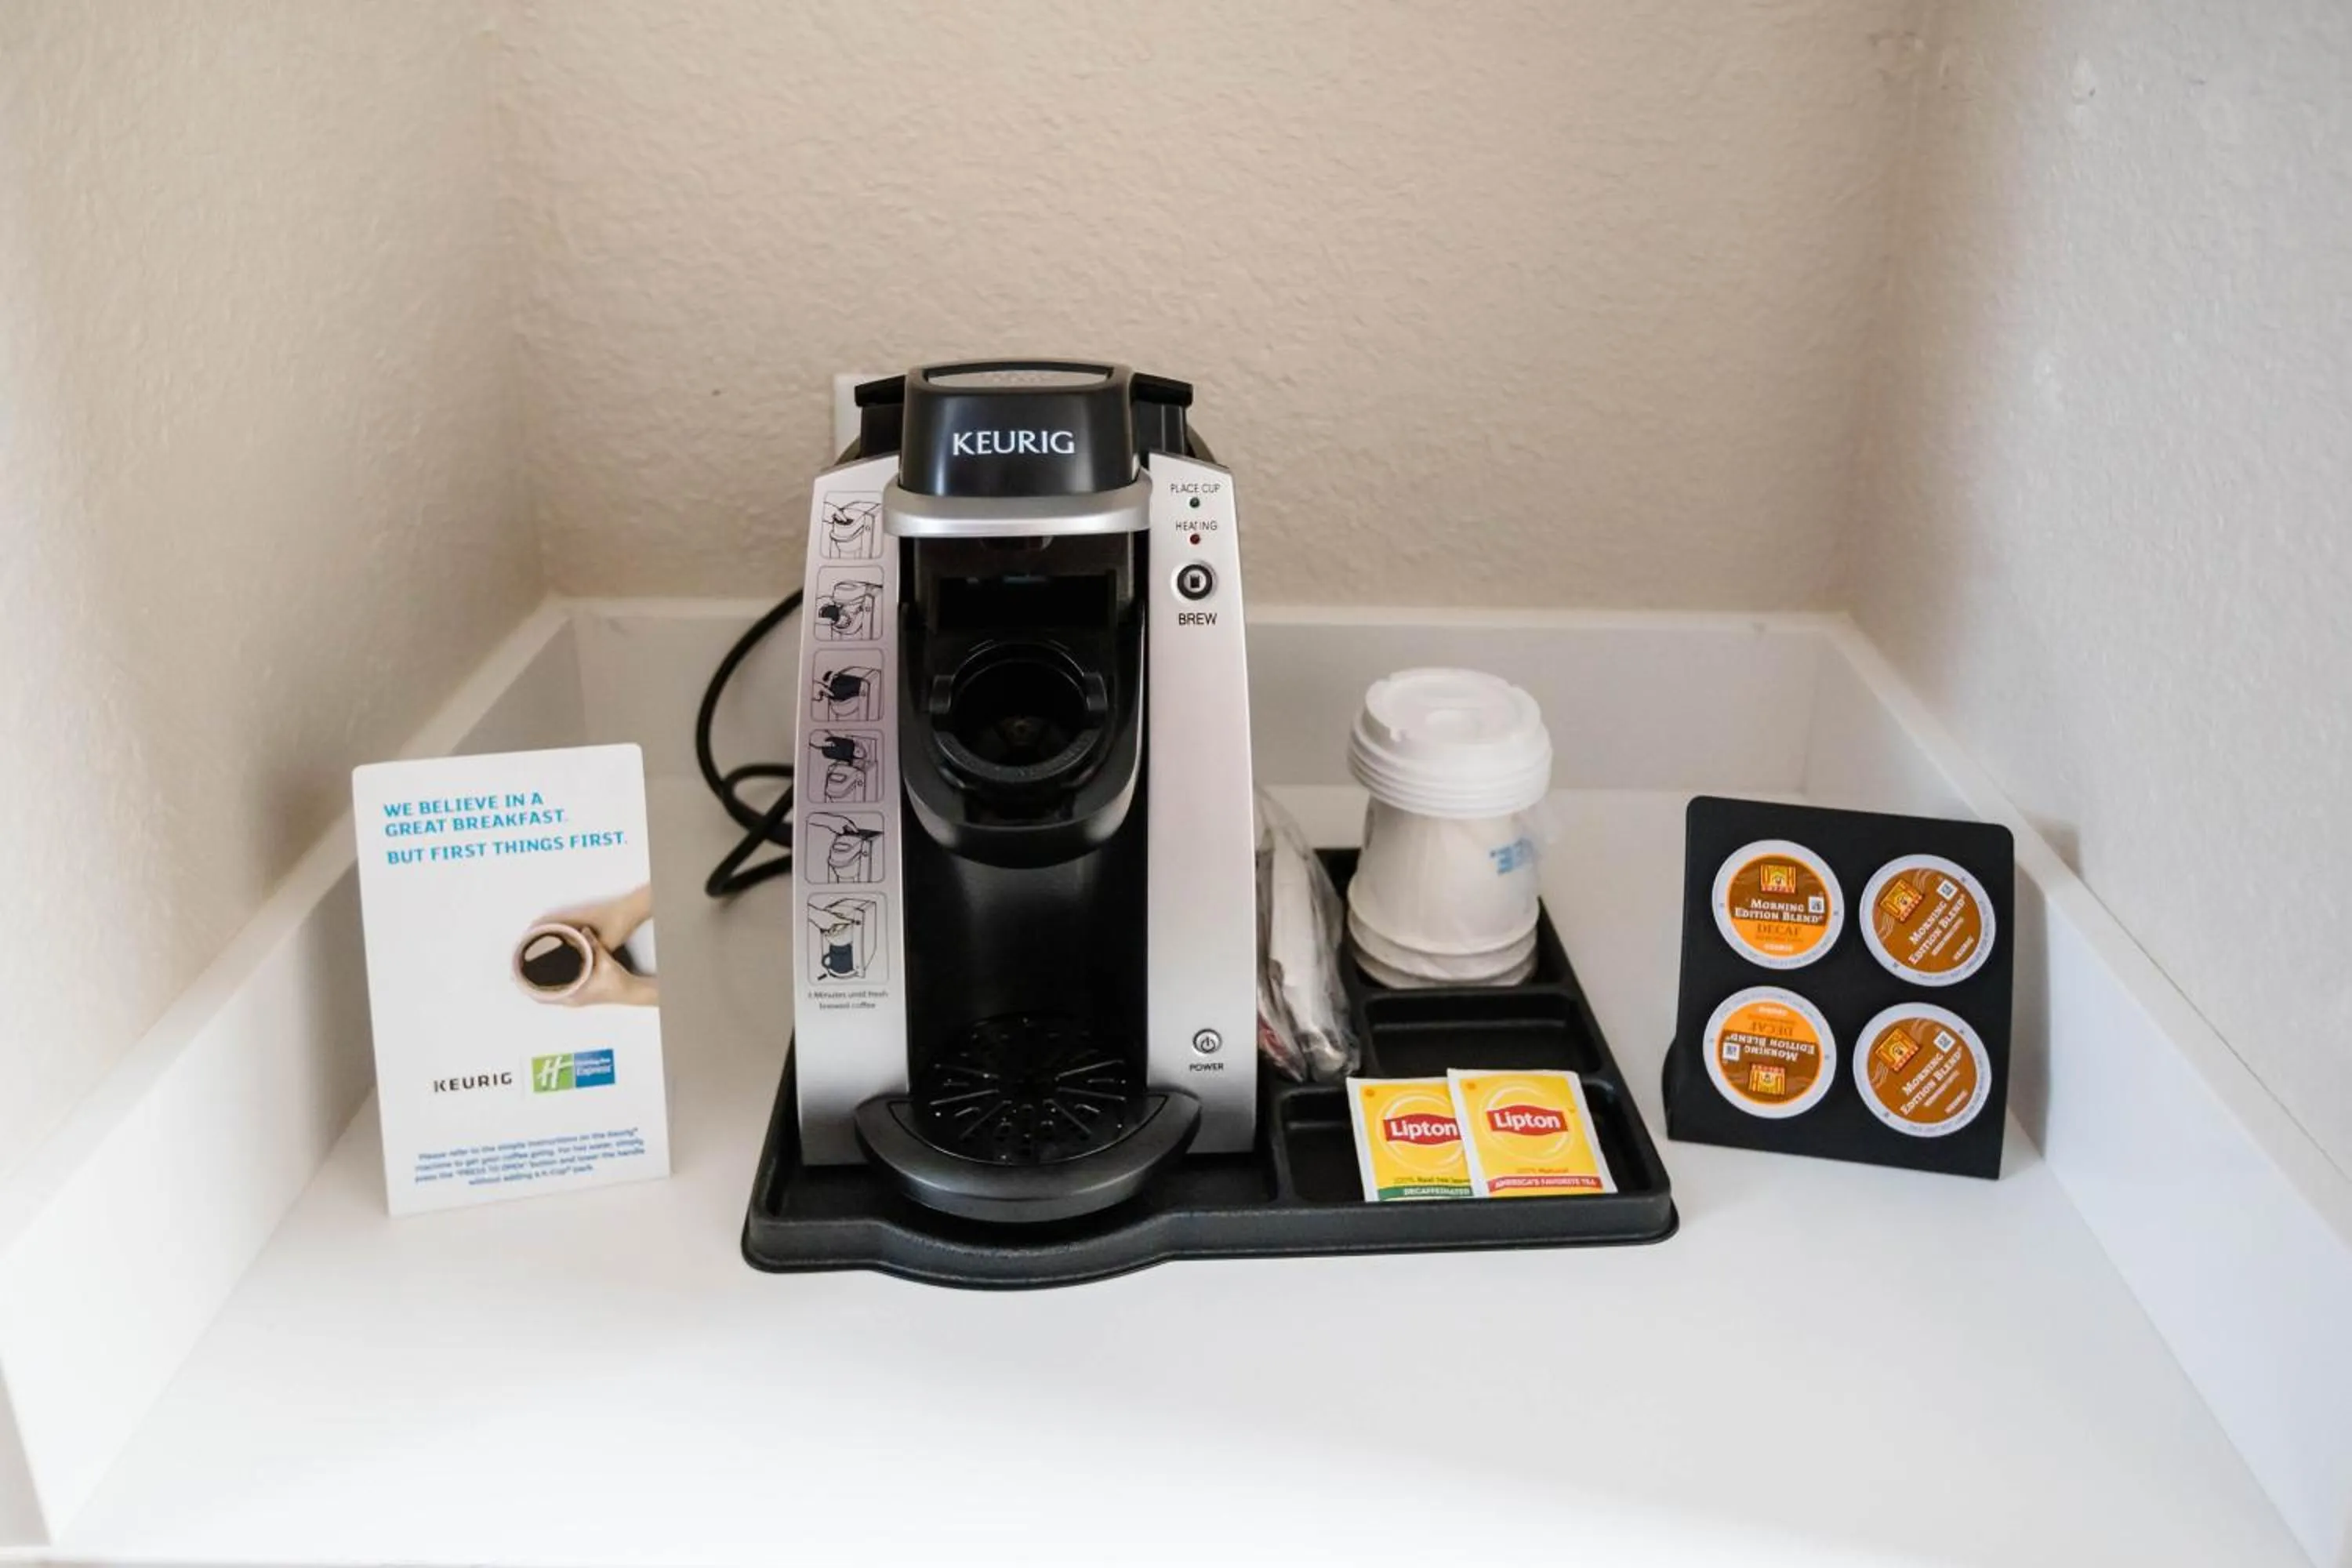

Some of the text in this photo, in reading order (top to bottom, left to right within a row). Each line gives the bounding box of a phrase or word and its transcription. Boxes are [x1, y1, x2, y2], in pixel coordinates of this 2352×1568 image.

[953, 430, 1075, 456] KEURIG
[1170, 483, 1221, 493] PLACE CUP
[1175, 521, 1218, 531] HEATING
[1178, 612, 1218, 626] BREW
[384, 792, 545, 818] WE BELIEVE IN A
[385, 818, 447, 838] GREAT
[387, 830, 628, 865] BUT FIRST THINGS FIRST.
[1734, 907, 1780, 920] EDITION
[1750, 898, 1806, 913] MORNING
[1757, 923, 1802, 936] DECAF
[1189, 1062, 1224, 1073] POWER
[434, 1072, 513, 1093] KEURIG
[1494, 1110, 1560, 1131] Lipton
[1390, 1119, 1459, 1141] Lipton
